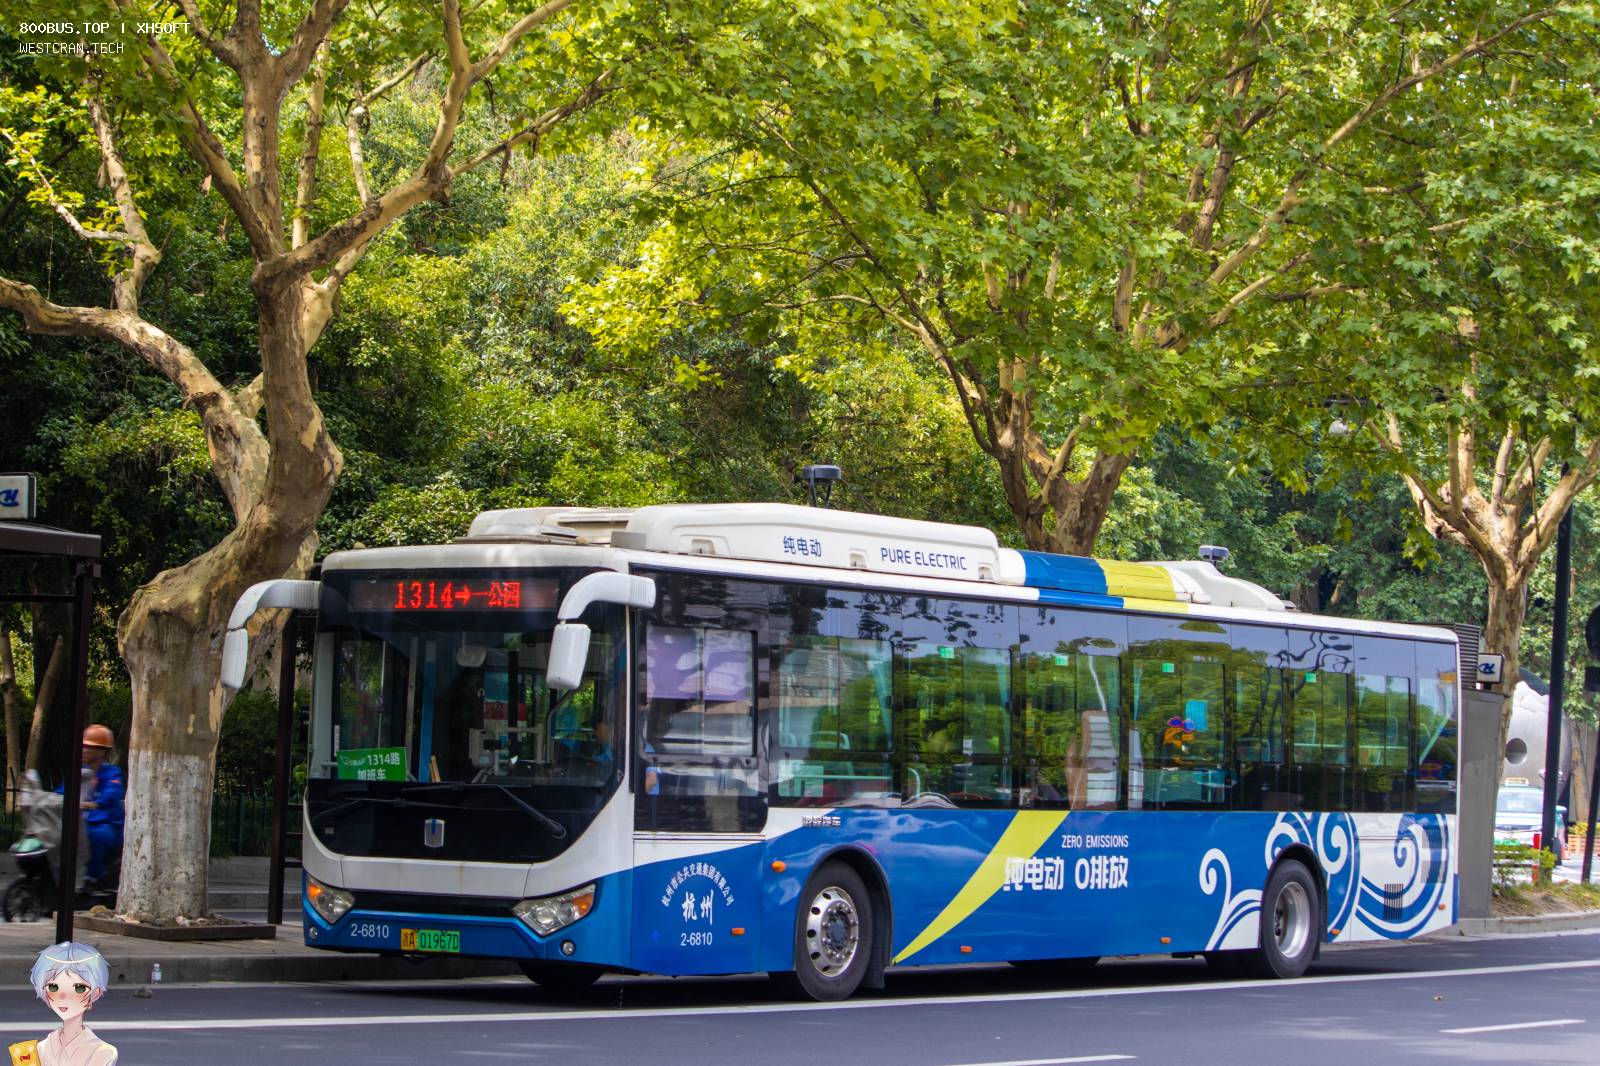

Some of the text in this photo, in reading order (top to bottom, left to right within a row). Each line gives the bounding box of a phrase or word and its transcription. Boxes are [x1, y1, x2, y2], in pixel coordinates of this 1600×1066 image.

[783, 536, 822, 557] 纯电动
[881, 548, 967, 570] PURE ELECTRIC
[394, 581, 453, 609] 1314
[367, 752, 401, 766] 1314路
[1061, 835, 1129, 848] ZERO EMISSIONS
[1003, 857, 1064, 891] 纯电动
[681, 889, 715, 926] 杭州
[350, 923, 390, 939] 2-6810
[680, 932, 713, 946] 2-6810
